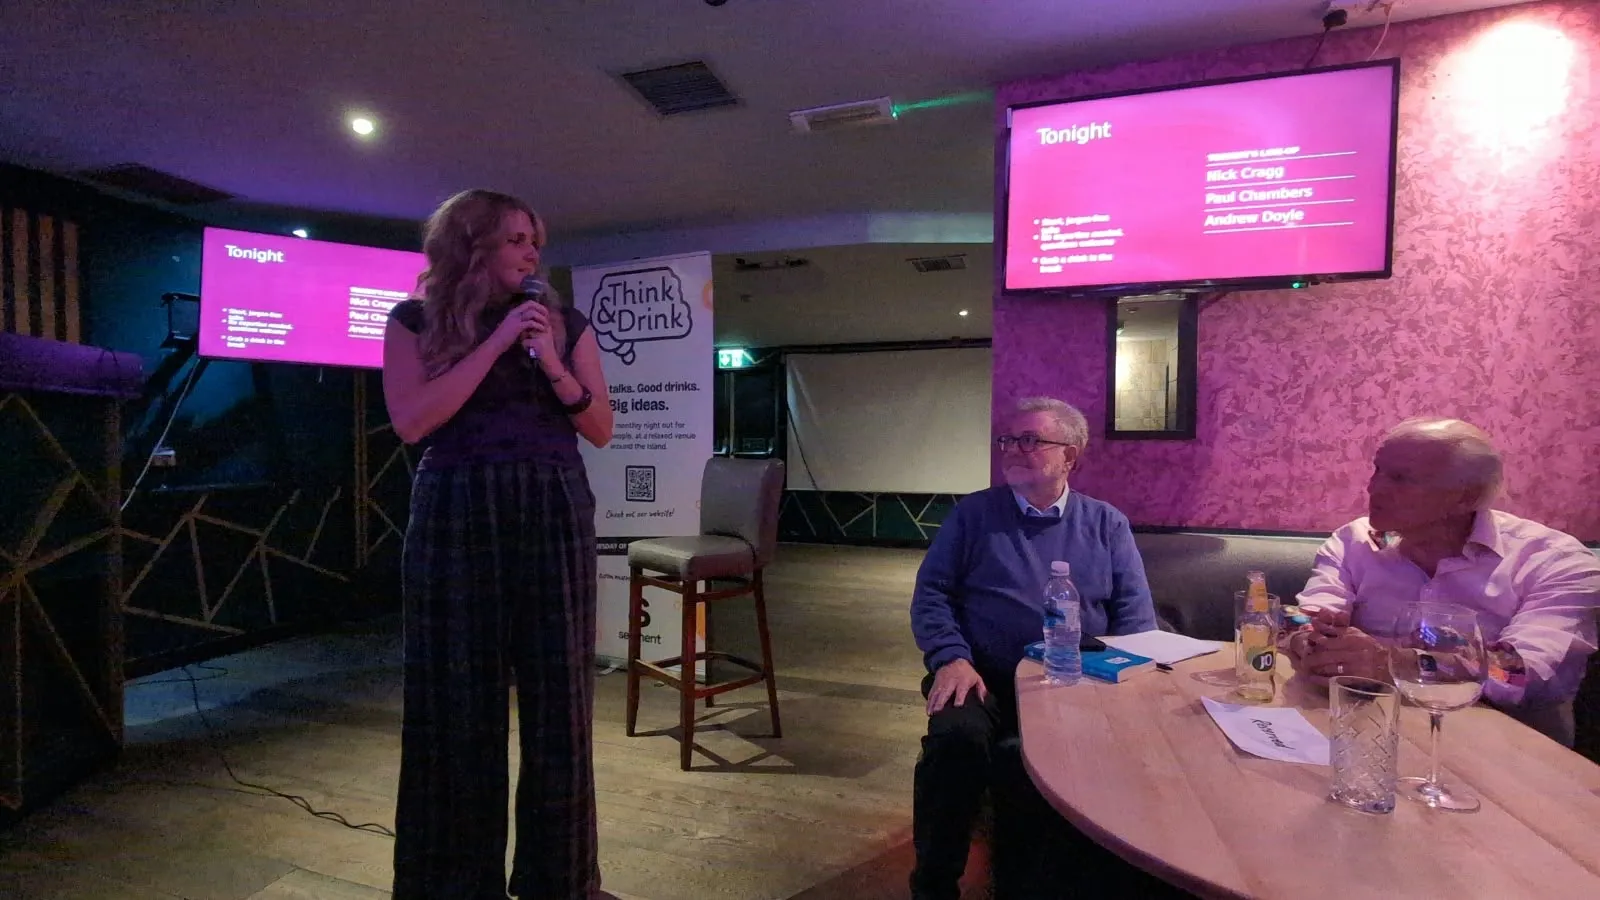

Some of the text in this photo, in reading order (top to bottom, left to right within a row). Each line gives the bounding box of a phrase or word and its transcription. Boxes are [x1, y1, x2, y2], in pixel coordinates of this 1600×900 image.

[1036, 121, 1112, 145] Tonight
[1206, 166, 1285, 182] Nick Cragg
[1205, 187, 1313, 204] Paul Chambers
[1204, 209, 1304, 227] Andrew Doyle
[224, 244, 284, 264] Tonight
[608, 276, 674, 306] Think
[349, 297, 370, 307] Nick
[349, 311, 369, 320] Paul
[597, 296, 683, 332] & Drink
[608, 381, 700, 394] talks. Good drinks.
[609, 398, 669, 414] Big ideas.
[615, 422, 642, 430] monthly
[643, 422, 661, 430] night
[605, 509, 624, 519] Check
[618, 631, 661, 645] seent
